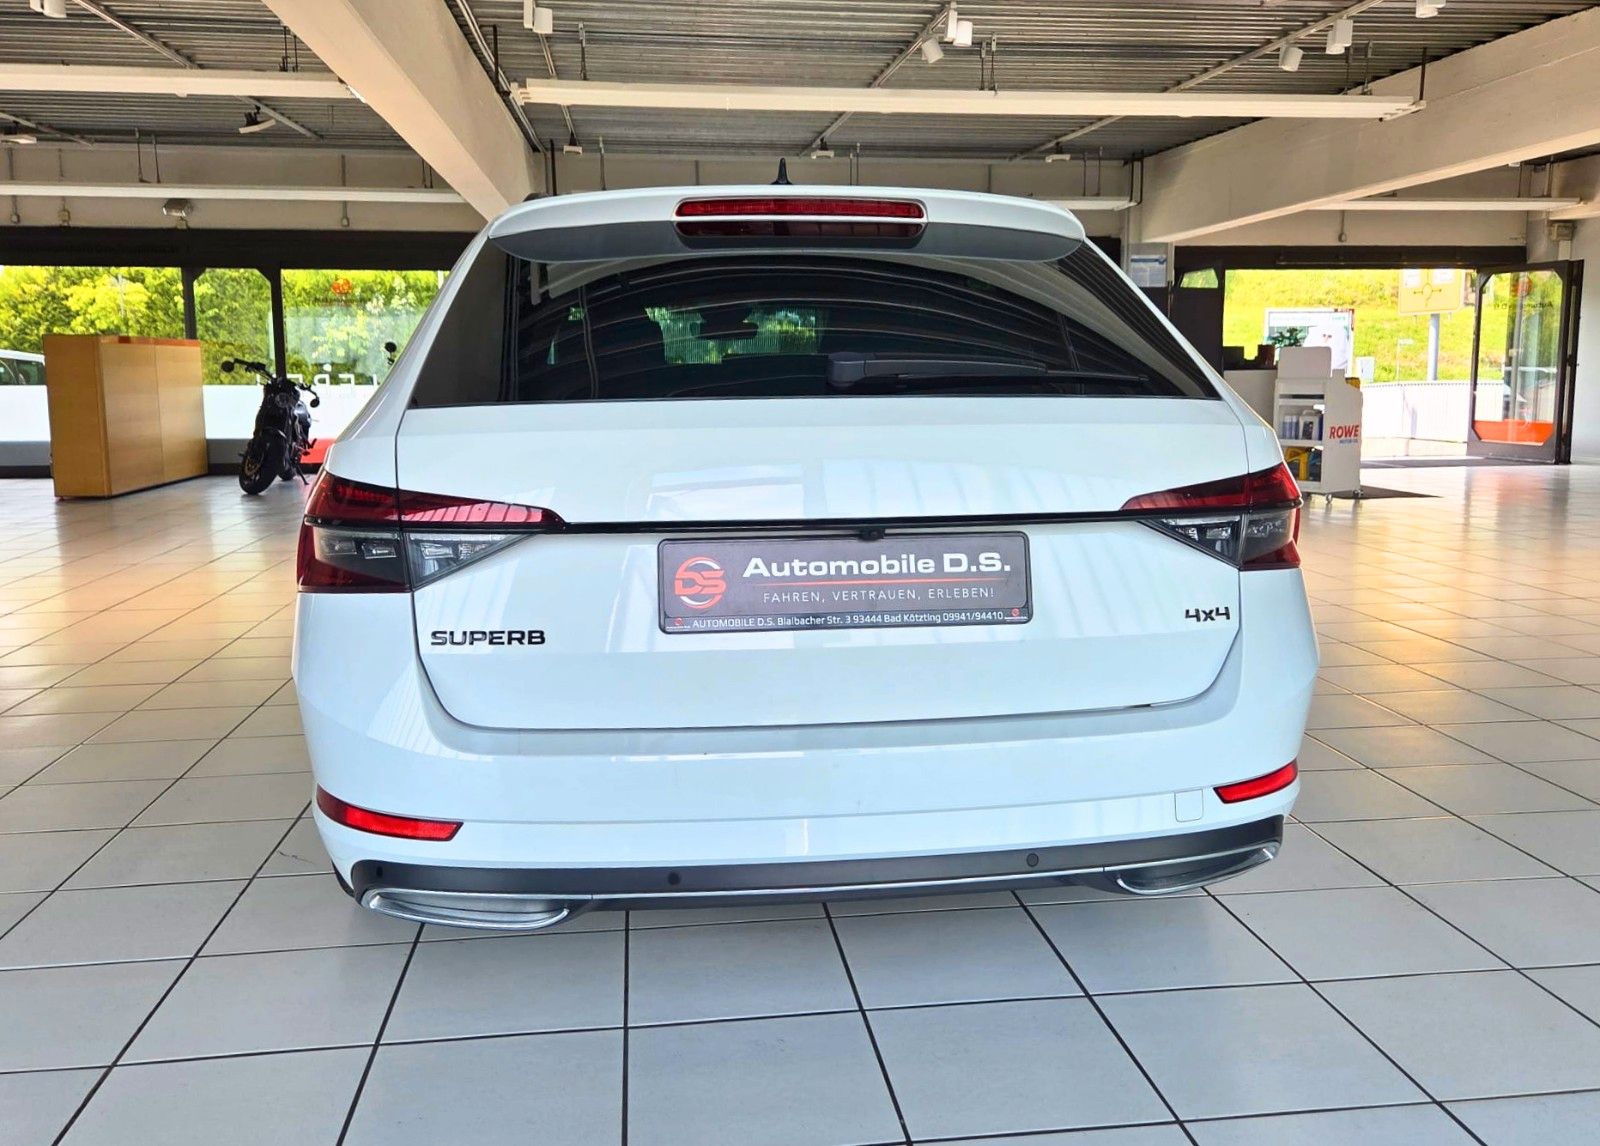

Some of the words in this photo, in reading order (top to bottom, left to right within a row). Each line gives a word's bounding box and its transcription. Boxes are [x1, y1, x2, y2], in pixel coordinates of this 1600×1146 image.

[1329, 424, 1360, 440] ROWE
[743, 554, 935, 577] Automobile
[943, 552, 1011, 573] D.S.
[763, 591, 825, 604] FAHREN,
[832, 589, 921, 602] VERTRAUEN,
[928, 587, 994, 600] ERLEBEN!
[692, 618, 755, 629] AUTOMOBILE
[757, 617, 775, 626] D.S.
[827, 615, 843, 625] Str.
[845, 615, 851, 624] 3
[853, 614, 882, 624] 93444
[884, 614, 901, 623] Bad
[903, 613, 941, 624] Kötzting
[942, 611, 1004, 621] 09941/94410
[1185, 606, 1231, 622] 4x4
[430, 630, 546, 646] SUPERB
